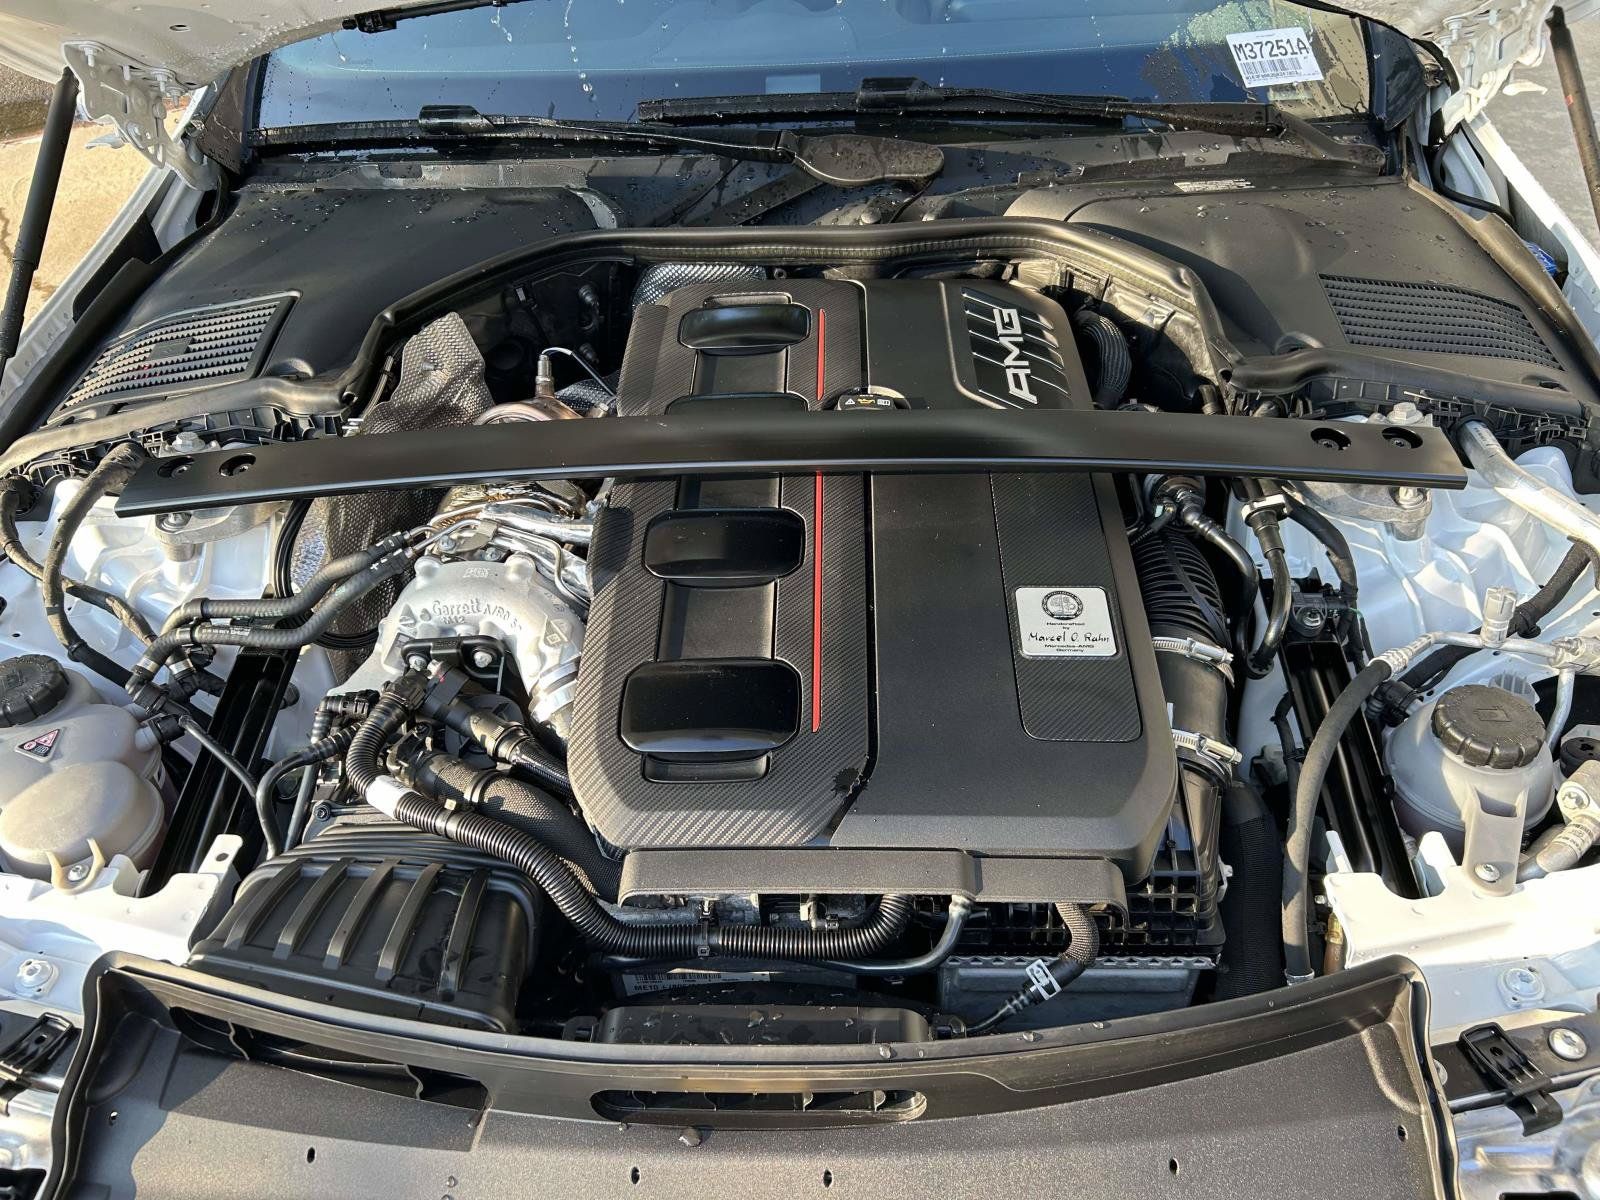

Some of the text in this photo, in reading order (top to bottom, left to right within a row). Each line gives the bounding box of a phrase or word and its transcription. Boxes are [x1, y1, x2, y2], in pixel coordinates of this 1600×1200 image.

[1233, 37, 1309, 61] M37251A
[993, 308, 1038, 405] AMG
[432, 598, 482, 616] Garrett
[1028, 631, 1065, 642] Marcel
